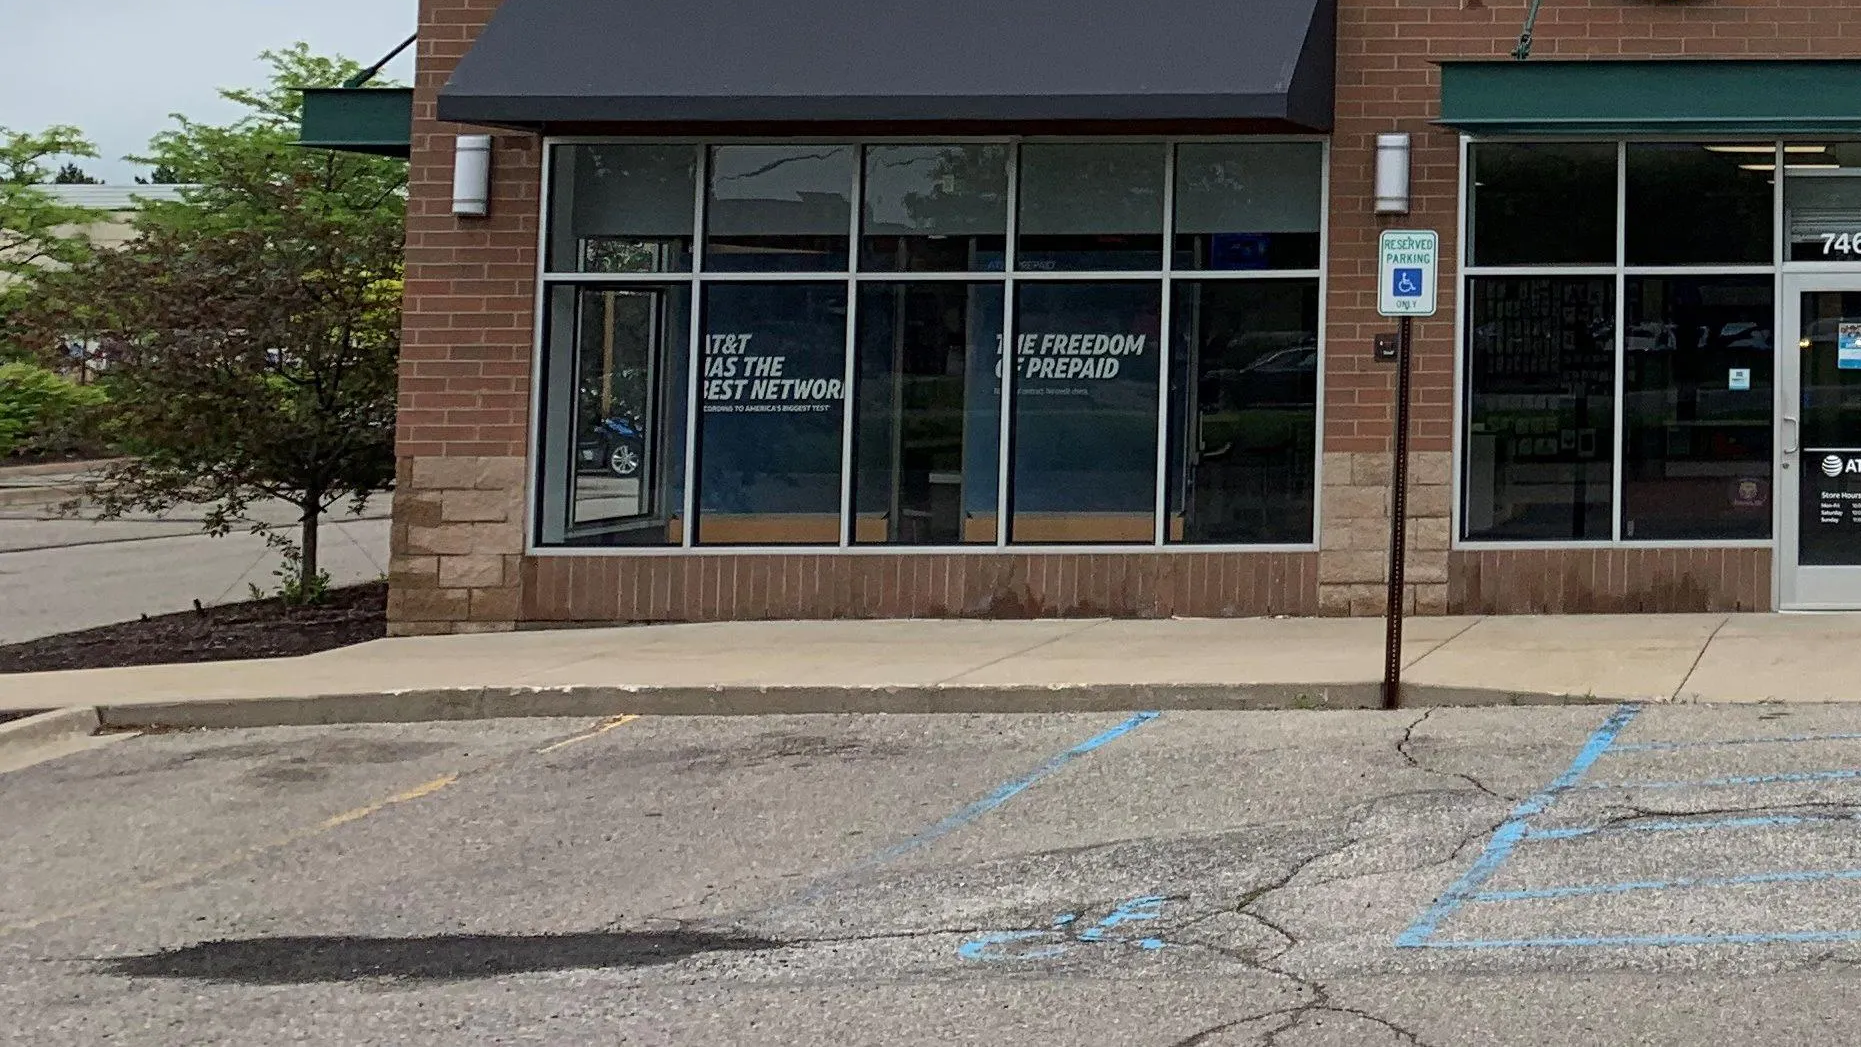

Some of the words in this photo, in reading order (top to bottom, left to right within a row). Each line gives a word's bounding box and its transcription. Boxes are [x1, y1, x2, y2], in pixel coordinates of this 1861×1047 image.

[1384, 239, 1433, 250] RESERVED
[1386, 253, 1430, 264] PARKING
[1396, 300, 1417, 309] ONLY
[1040, 334, 1147, 356] FREEDOM
[743, 356, 785, 377] THE
[1026, 357, 1120, 379] PREPAID
[750, 378, 845, 400] NETWOR
[1821, 491, 1841, 499] Store
